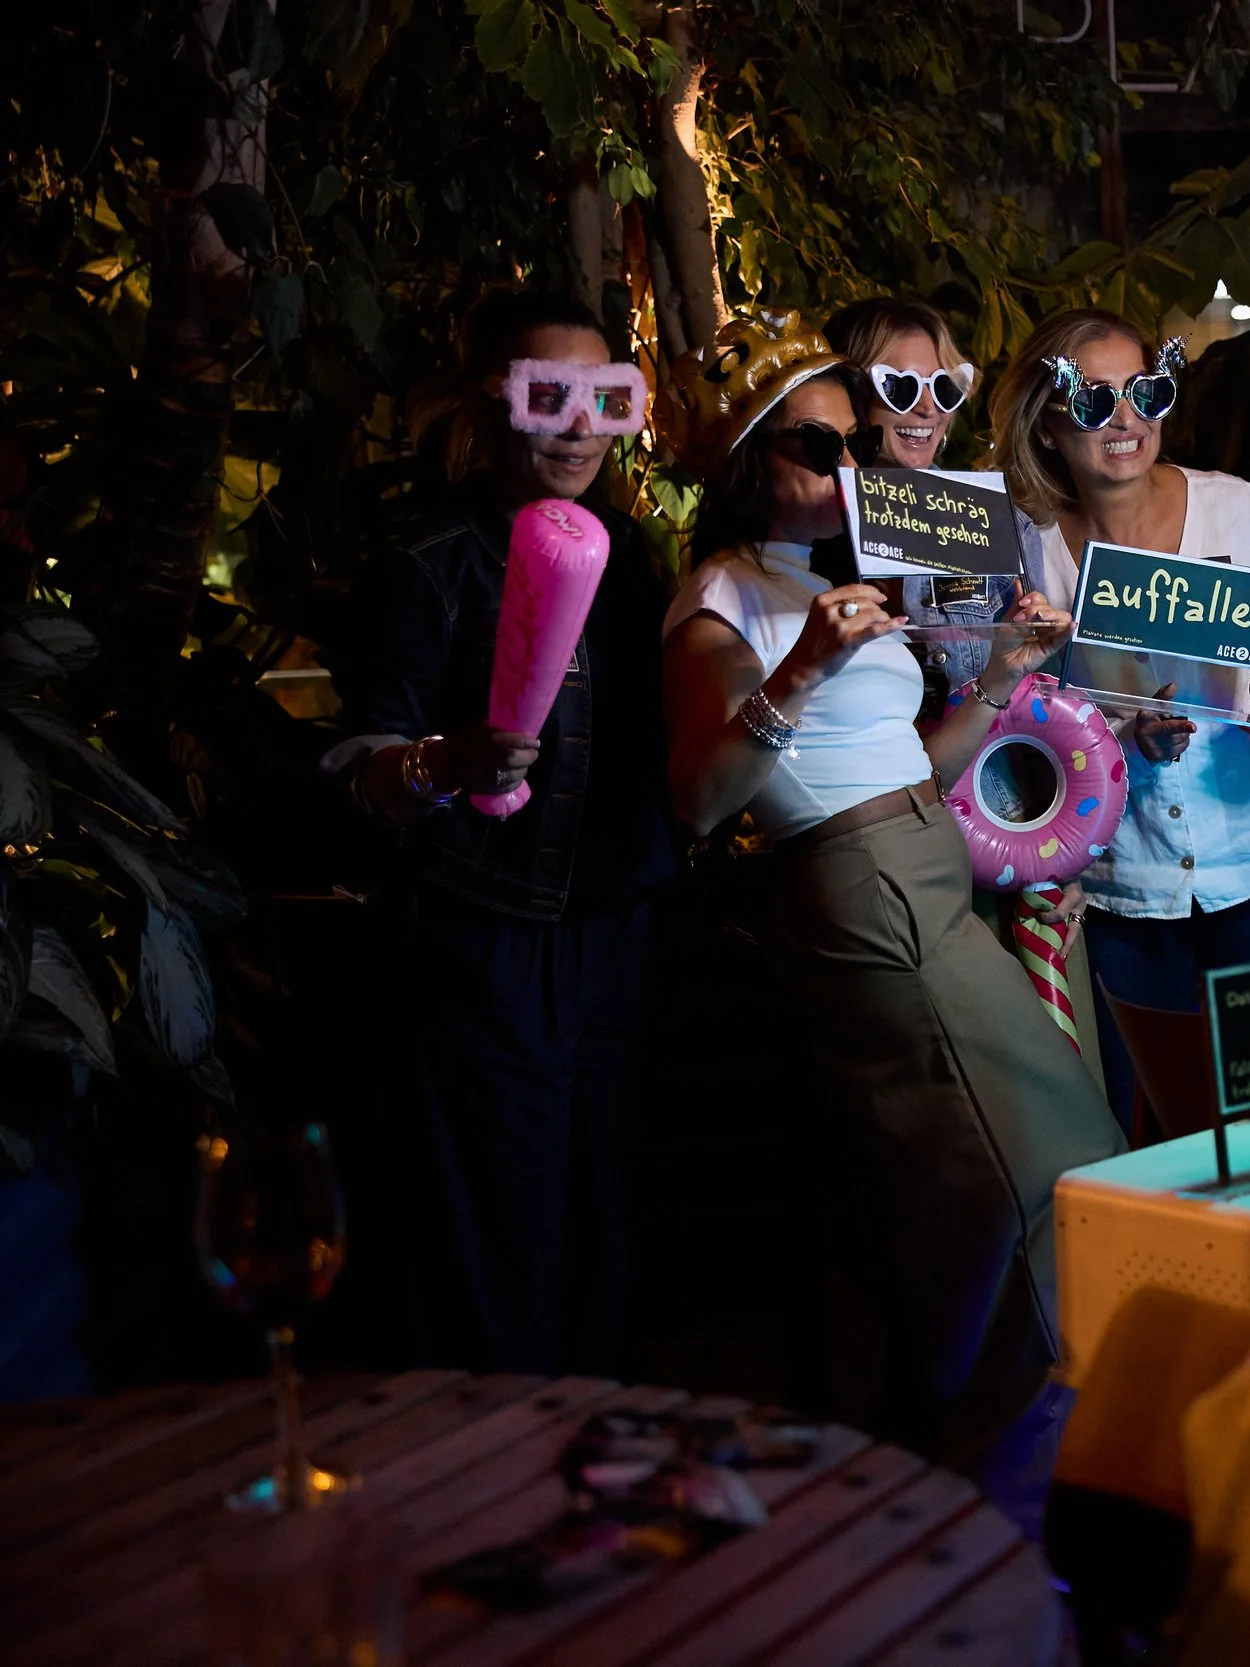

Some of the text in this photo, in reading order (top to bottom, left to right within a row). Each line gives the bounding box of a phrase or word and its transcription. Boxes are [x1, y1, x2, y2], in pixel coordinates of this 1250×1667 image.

[859, 471, 990, 529] bitzeli schräg
[864, 500, 990, 547] trotzdem gesehen
